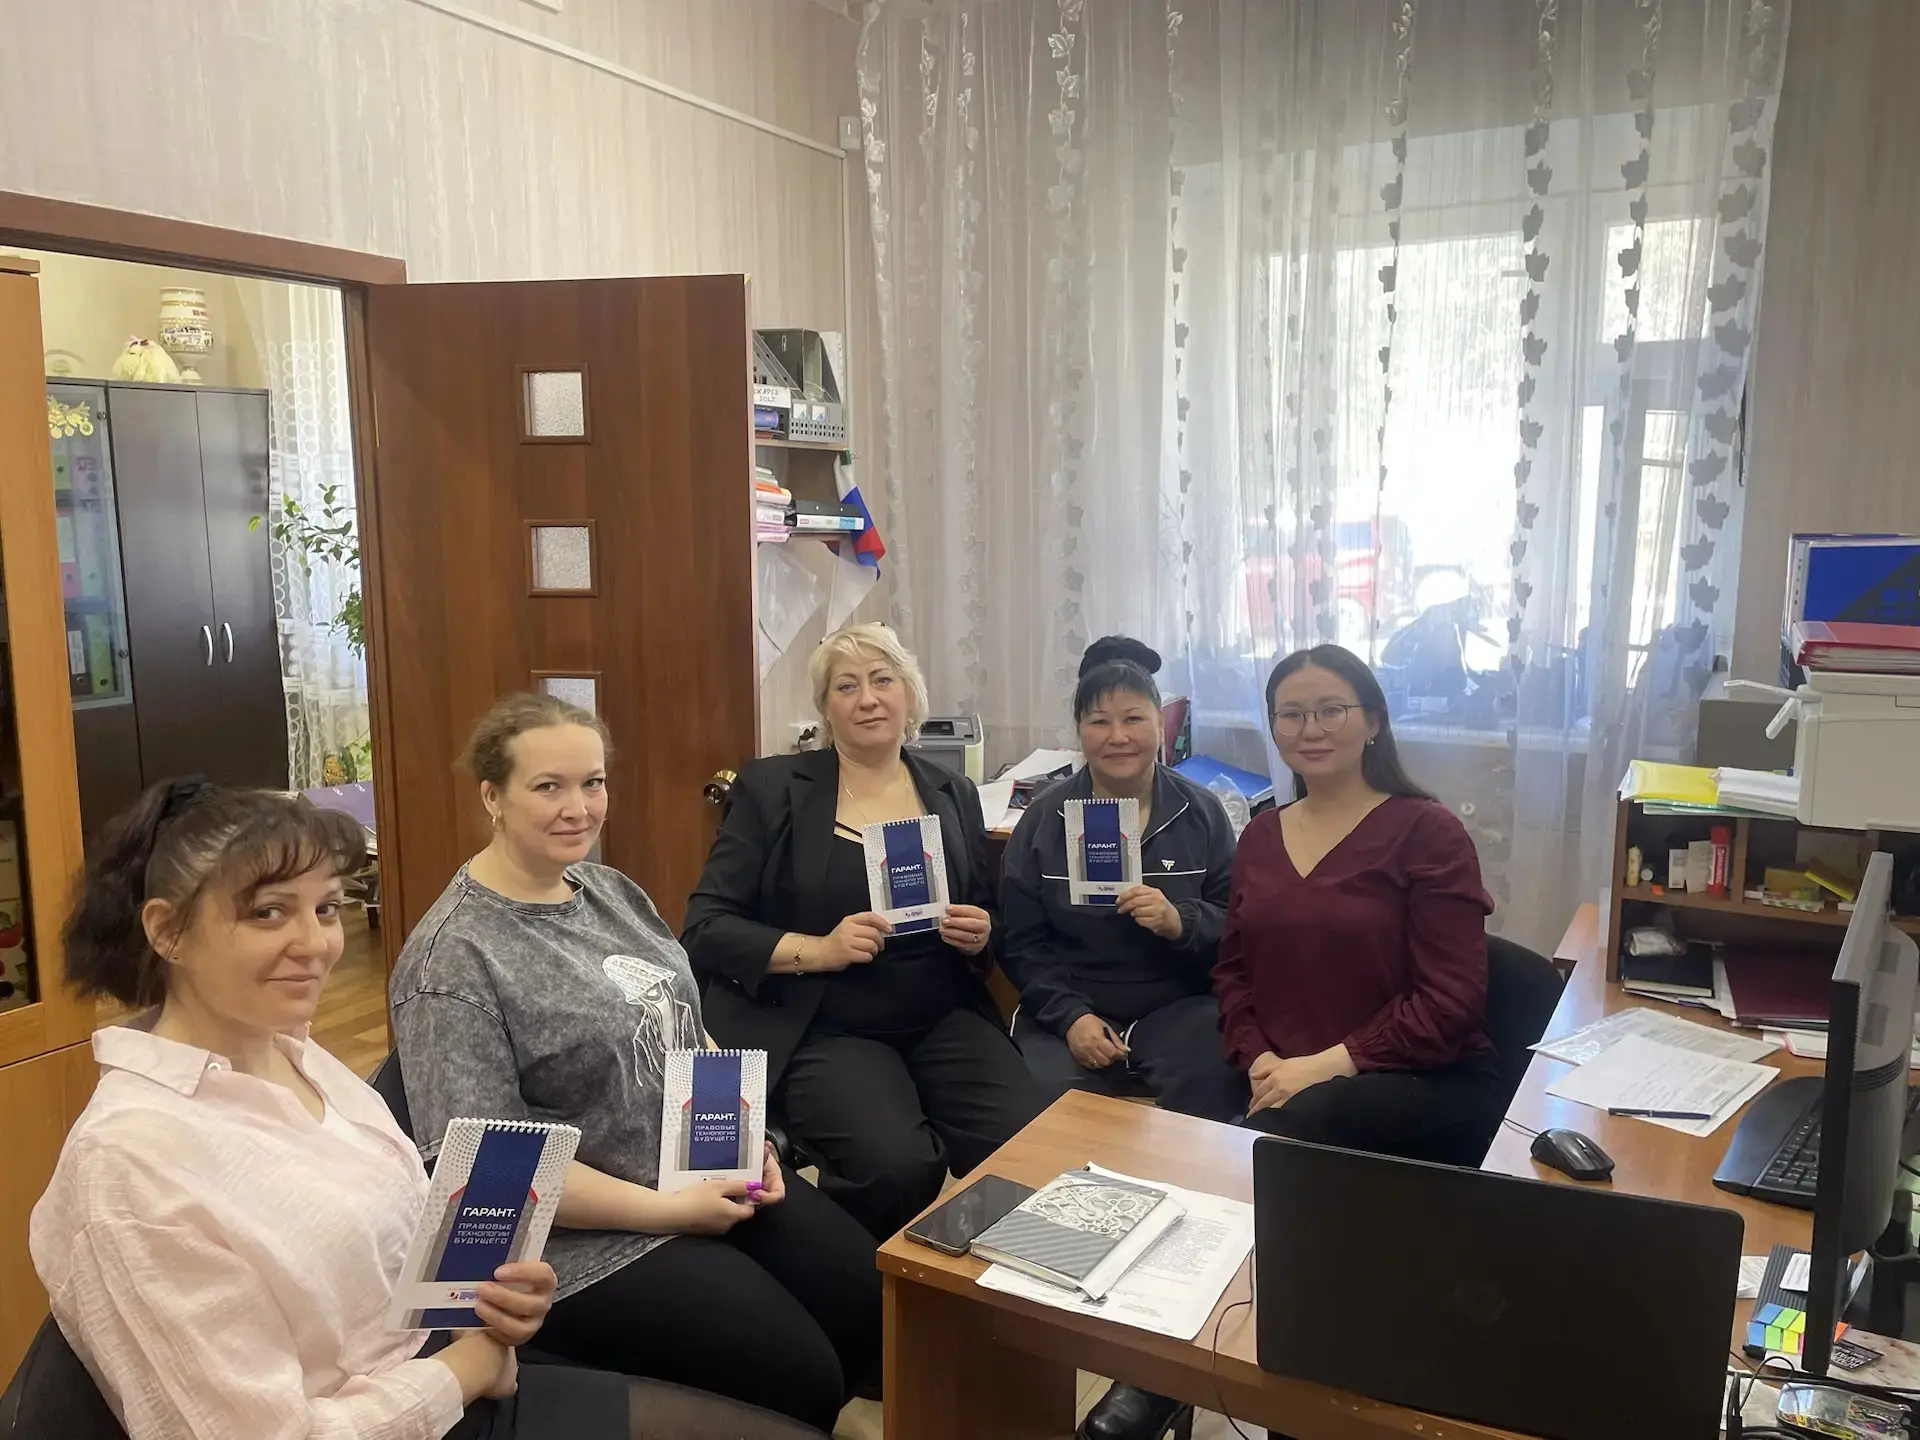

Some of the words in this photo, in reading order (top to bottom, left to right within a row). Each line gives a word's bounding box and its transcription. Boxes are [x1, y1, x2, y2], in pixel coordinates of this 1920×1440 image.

[891, 864, 923, 874] ГАРАНТ.
[694, 1112, 737, 1121] ГАРАНТ.
[462, 1207, 517, 1218] ГАРАНТ.
[458, 1222, 513, 1230] ПРАВОВЫЕ
[453, 1237, 508, 1245] БУДУЩЕГО
